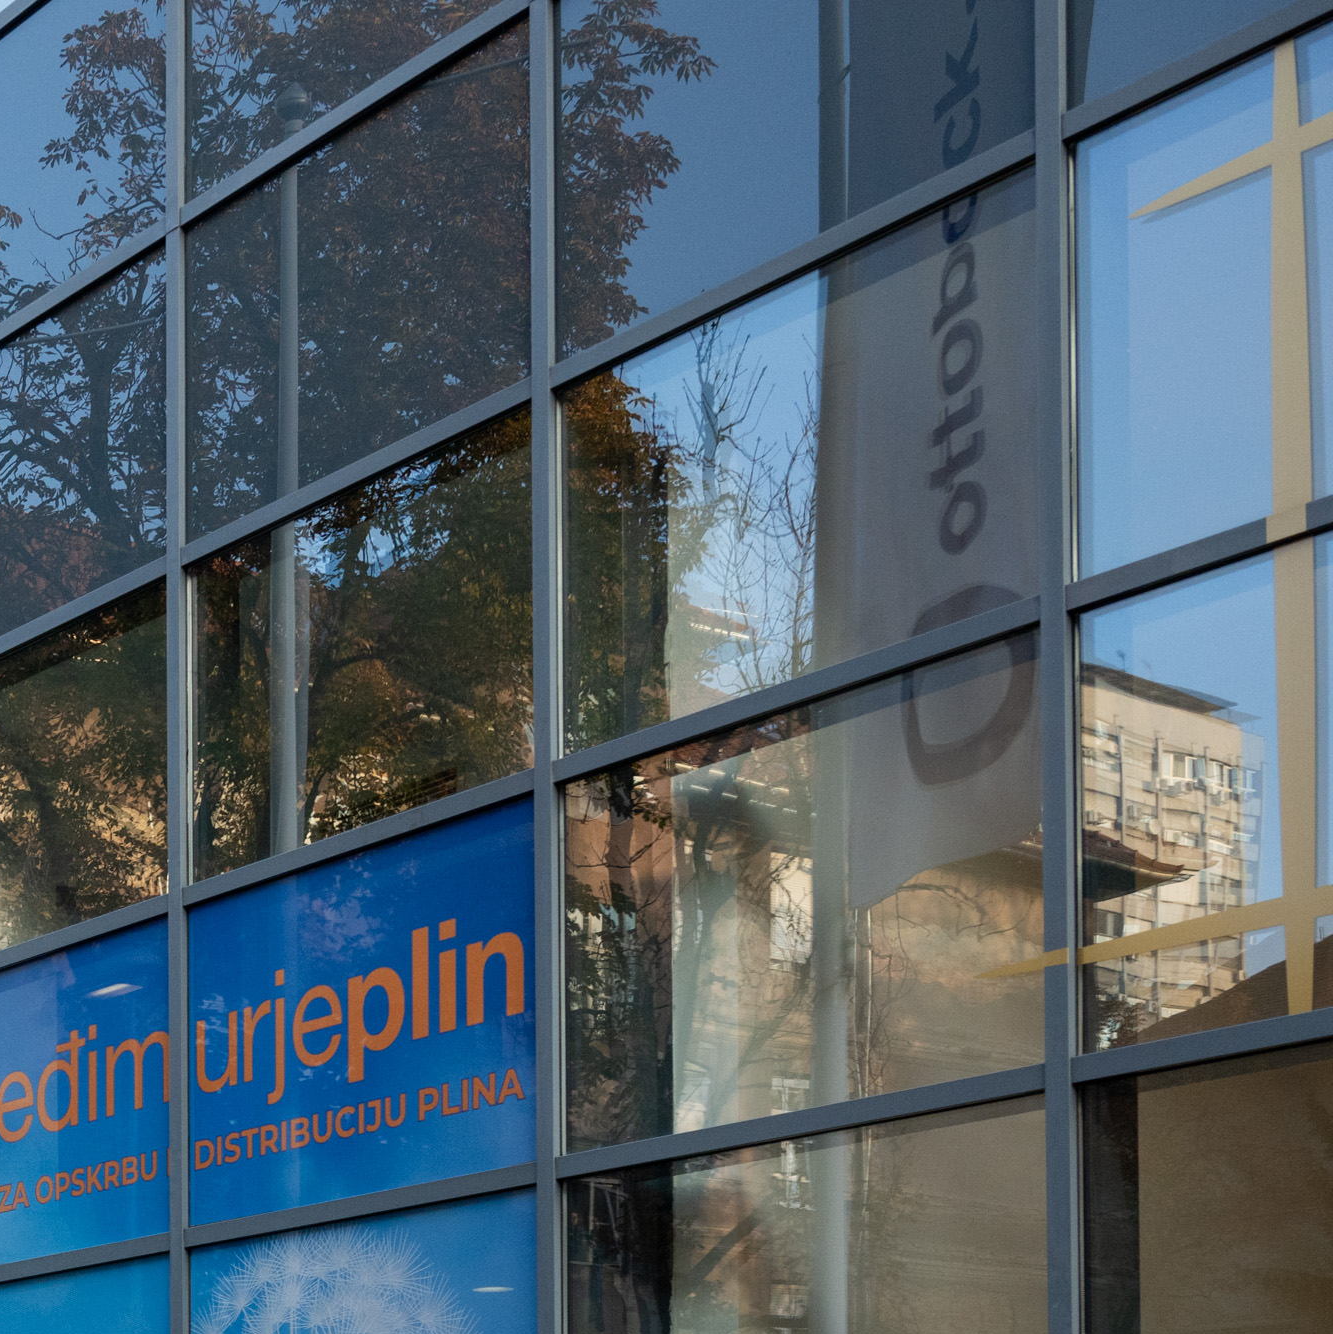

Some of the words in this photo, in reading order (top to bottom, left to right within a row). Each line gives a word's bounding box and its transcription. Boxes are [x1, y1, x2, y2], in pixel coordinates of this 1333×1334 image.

[35, 1149, 158, 1204] OPSKRBU
[194, 1093, 406, 1171] DISTRIBUCIJU
[419, 1067, 525, 1121] PLINA
